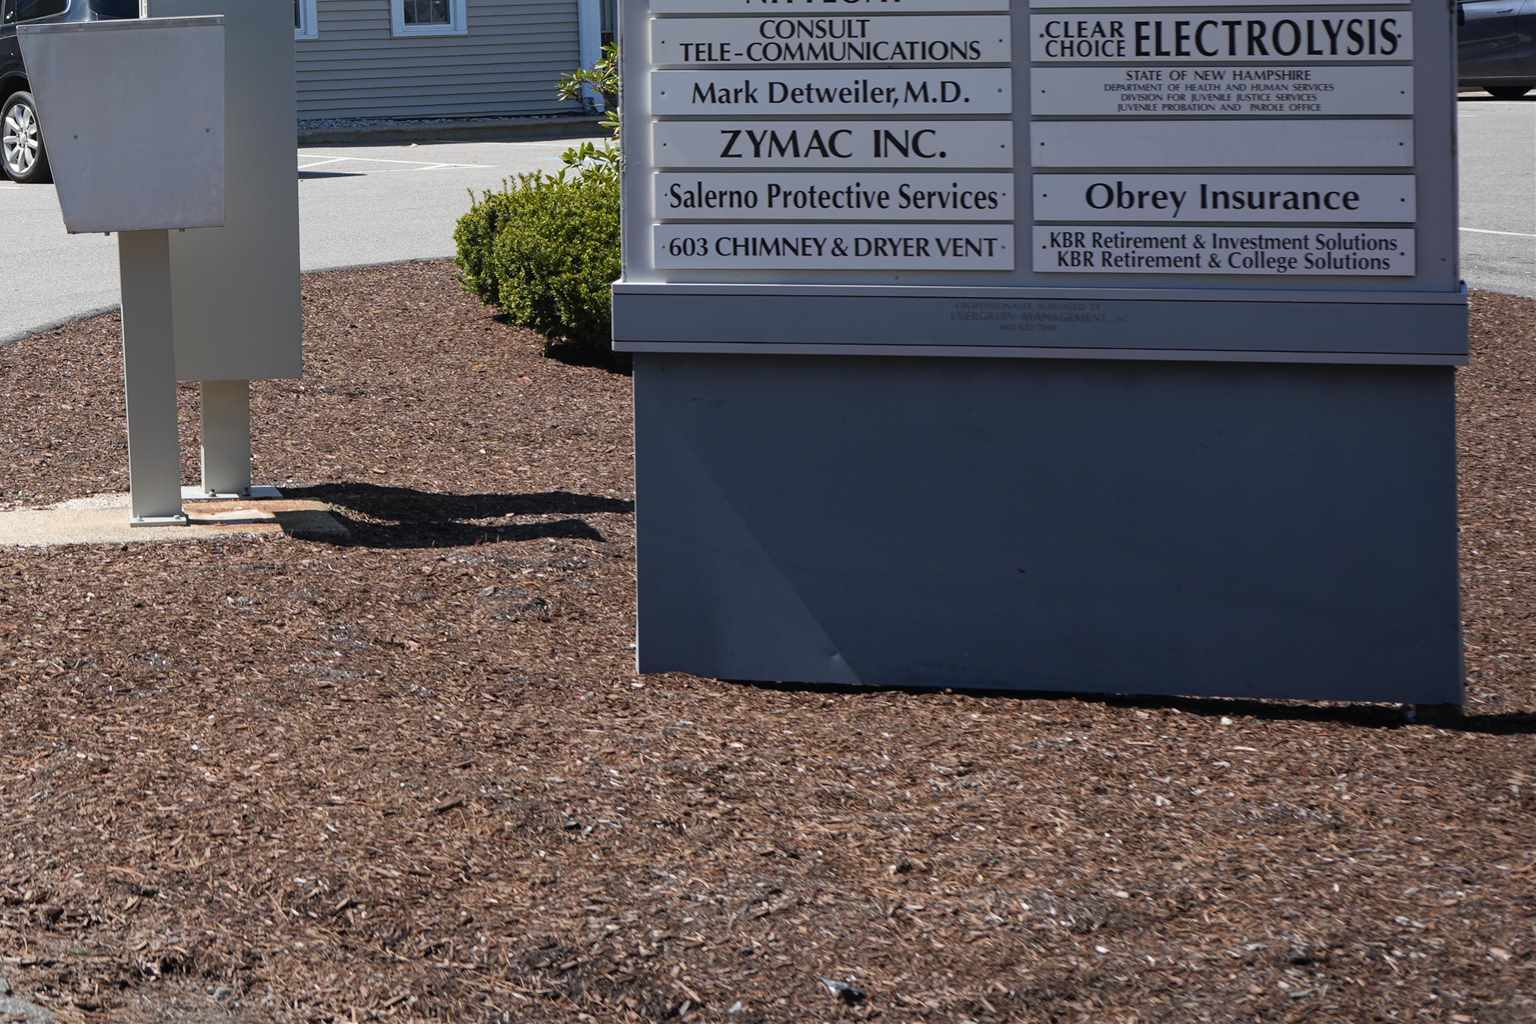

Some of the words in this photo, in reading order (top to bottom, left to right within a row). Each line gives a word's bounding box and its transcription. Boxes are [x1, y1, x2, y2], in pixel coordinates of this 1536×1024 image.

[759, 19, 871, 39] CONSULT
[1044, 20, 1124, 38] CLEAR
[1134, 18, 1398, 57] ELECTROLYSIS
[680, 40, 982, 62] TELE-COMMUNICATIONS
[1044, 39, 1126, 58] CHOICE
[1126, 70, 1163, 81] STATE
[1169, 70, 1188, 81] OF
[1193, 70, 1226, 81] NEW
[1232, 70, 1312, 81] HAMPSHIRE
[691, 80, 759, 104] Mark
[768, 79, 899, 108] Detweiler,
[903, 80, 971, 104] M.D.
[1104, 83, 1162, 92] DEPARTMENT
[1167, 83, 1181, 92] OF
[1185, 83, 1221, 92] HEALTH
[1225, 83, 1247, 92] AND
[1250, 83, 1289, 92] HUMAN
[1292, 83, 1335, 92] SERVICES
[1120, 93, 1163, 102] DIVISION
[1167, 93, 1186, 102] FOR
[1190, 93, 1232, 103] JUVENILE
[1236, 93, 1271, 103] JUSTICE
[1275, 93, 1318, 102] SERVICES
[1117, 103, 1159, 113] JUVENILE
[1161, 103, 1216, 112] PROBATION
[1220, 103, 1242, 112] AND
[1249, 103, 1284, 112] PAROLE
[1288, 103, 1321, 112] OFFICE
[720, 129, 853, 158] ZYMAC
[872, 129, 947, 158] INC.
[669, 181, 759, 209] Salerno
[767, 182, 890, 209] Protective
[898, 182, 998, 209] Services
[1084, 181, 1187, 218] Obrey
[1199, 183, 1361, 210] Insurance
[669, 237, 709, 257] 603
[715, 237, 828, 257] CHIMNEY
[830, 237, 849, 257] &
[854, 237, 930, 257] DRYER
[935, 237, 999, 258] VENT
[1049, 231, 1086, 249] KBR
[1092, 231, 1186, 250] Retirement
[1192, 234, 1207, 250] &
[1211, 233, 1310, 251] Investment
[1315, 232, 1398, 252] Solutions
[1057, 250, 1095, 268] KBR
[1101, 250, 1201, 269] Retirement
[1207, 252, 1222, 269] &
[1227, 251, 1299, 273] College
[1304, 251, 1391, 271] Solutions
